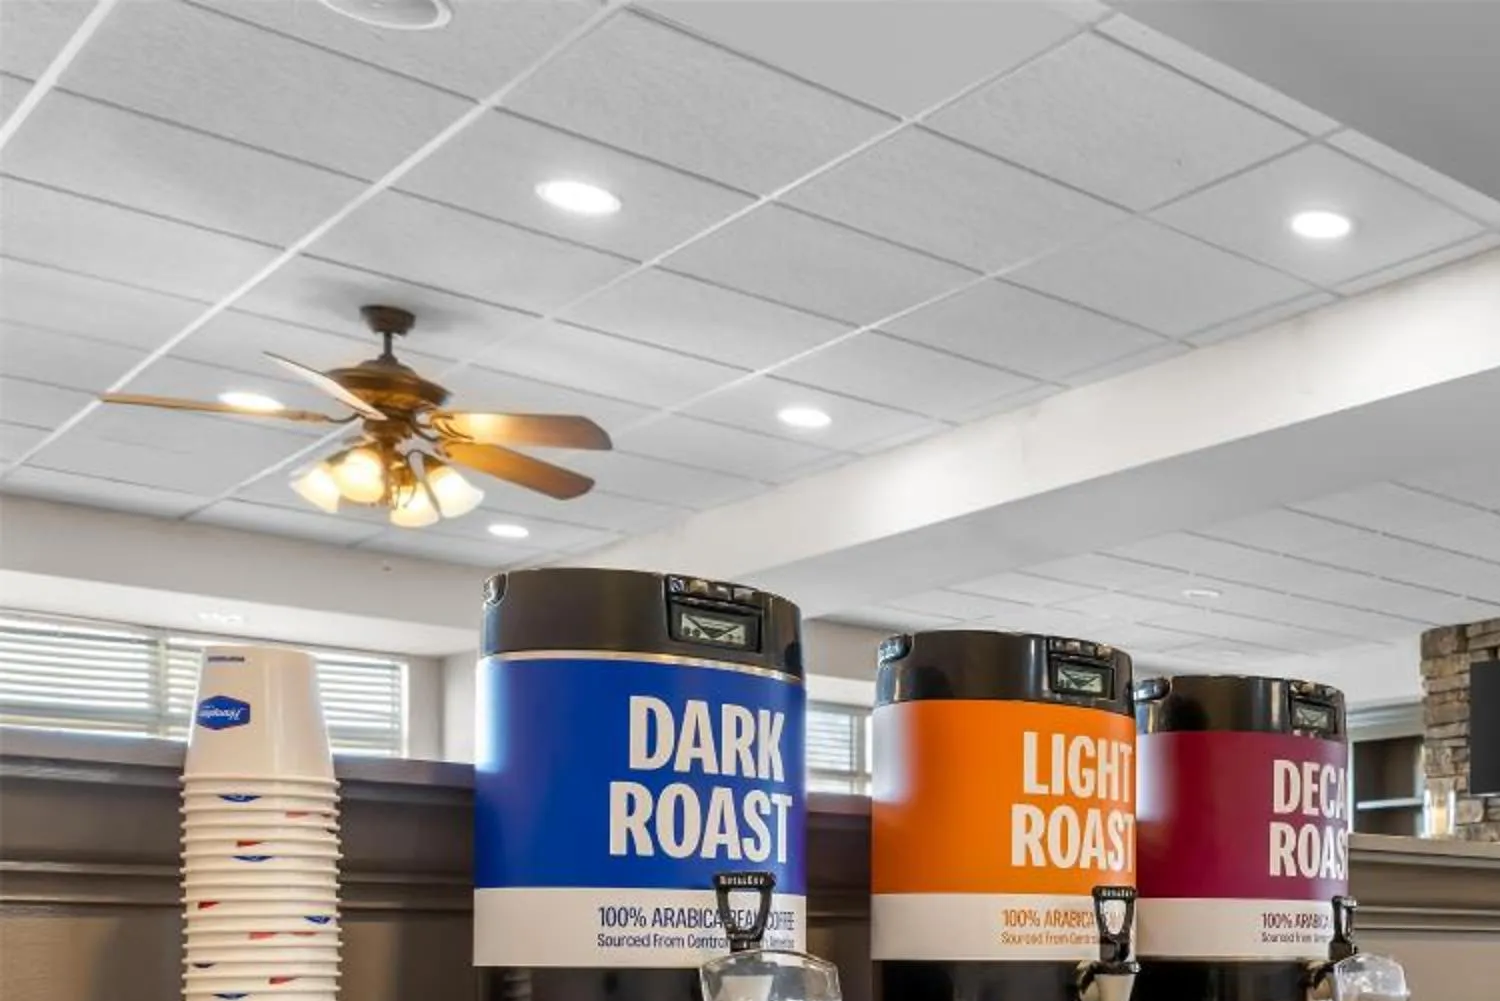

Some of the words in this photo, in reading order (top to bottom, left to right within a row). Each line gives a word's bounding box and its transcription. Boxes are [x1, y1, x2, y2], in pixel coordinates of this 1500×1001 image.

[629, 695, 785, 783] DARK
[1023, 731, 1133, 804] LIGHT
[1273, 759, 1346, 819] DECA
[609, 781, 793, 863] ROAST
[1011, 803, 1135, 873] ROAST
[1269, 821, 1348, 881] ROAS
[597, 932, 651, 948] Sourced
[653, 933, 685, 949] From
[598, 906, 647, 928] 100%
[651, 907, 724, 929] ARABICA
[1003, 909, 1041, 928] 100%
